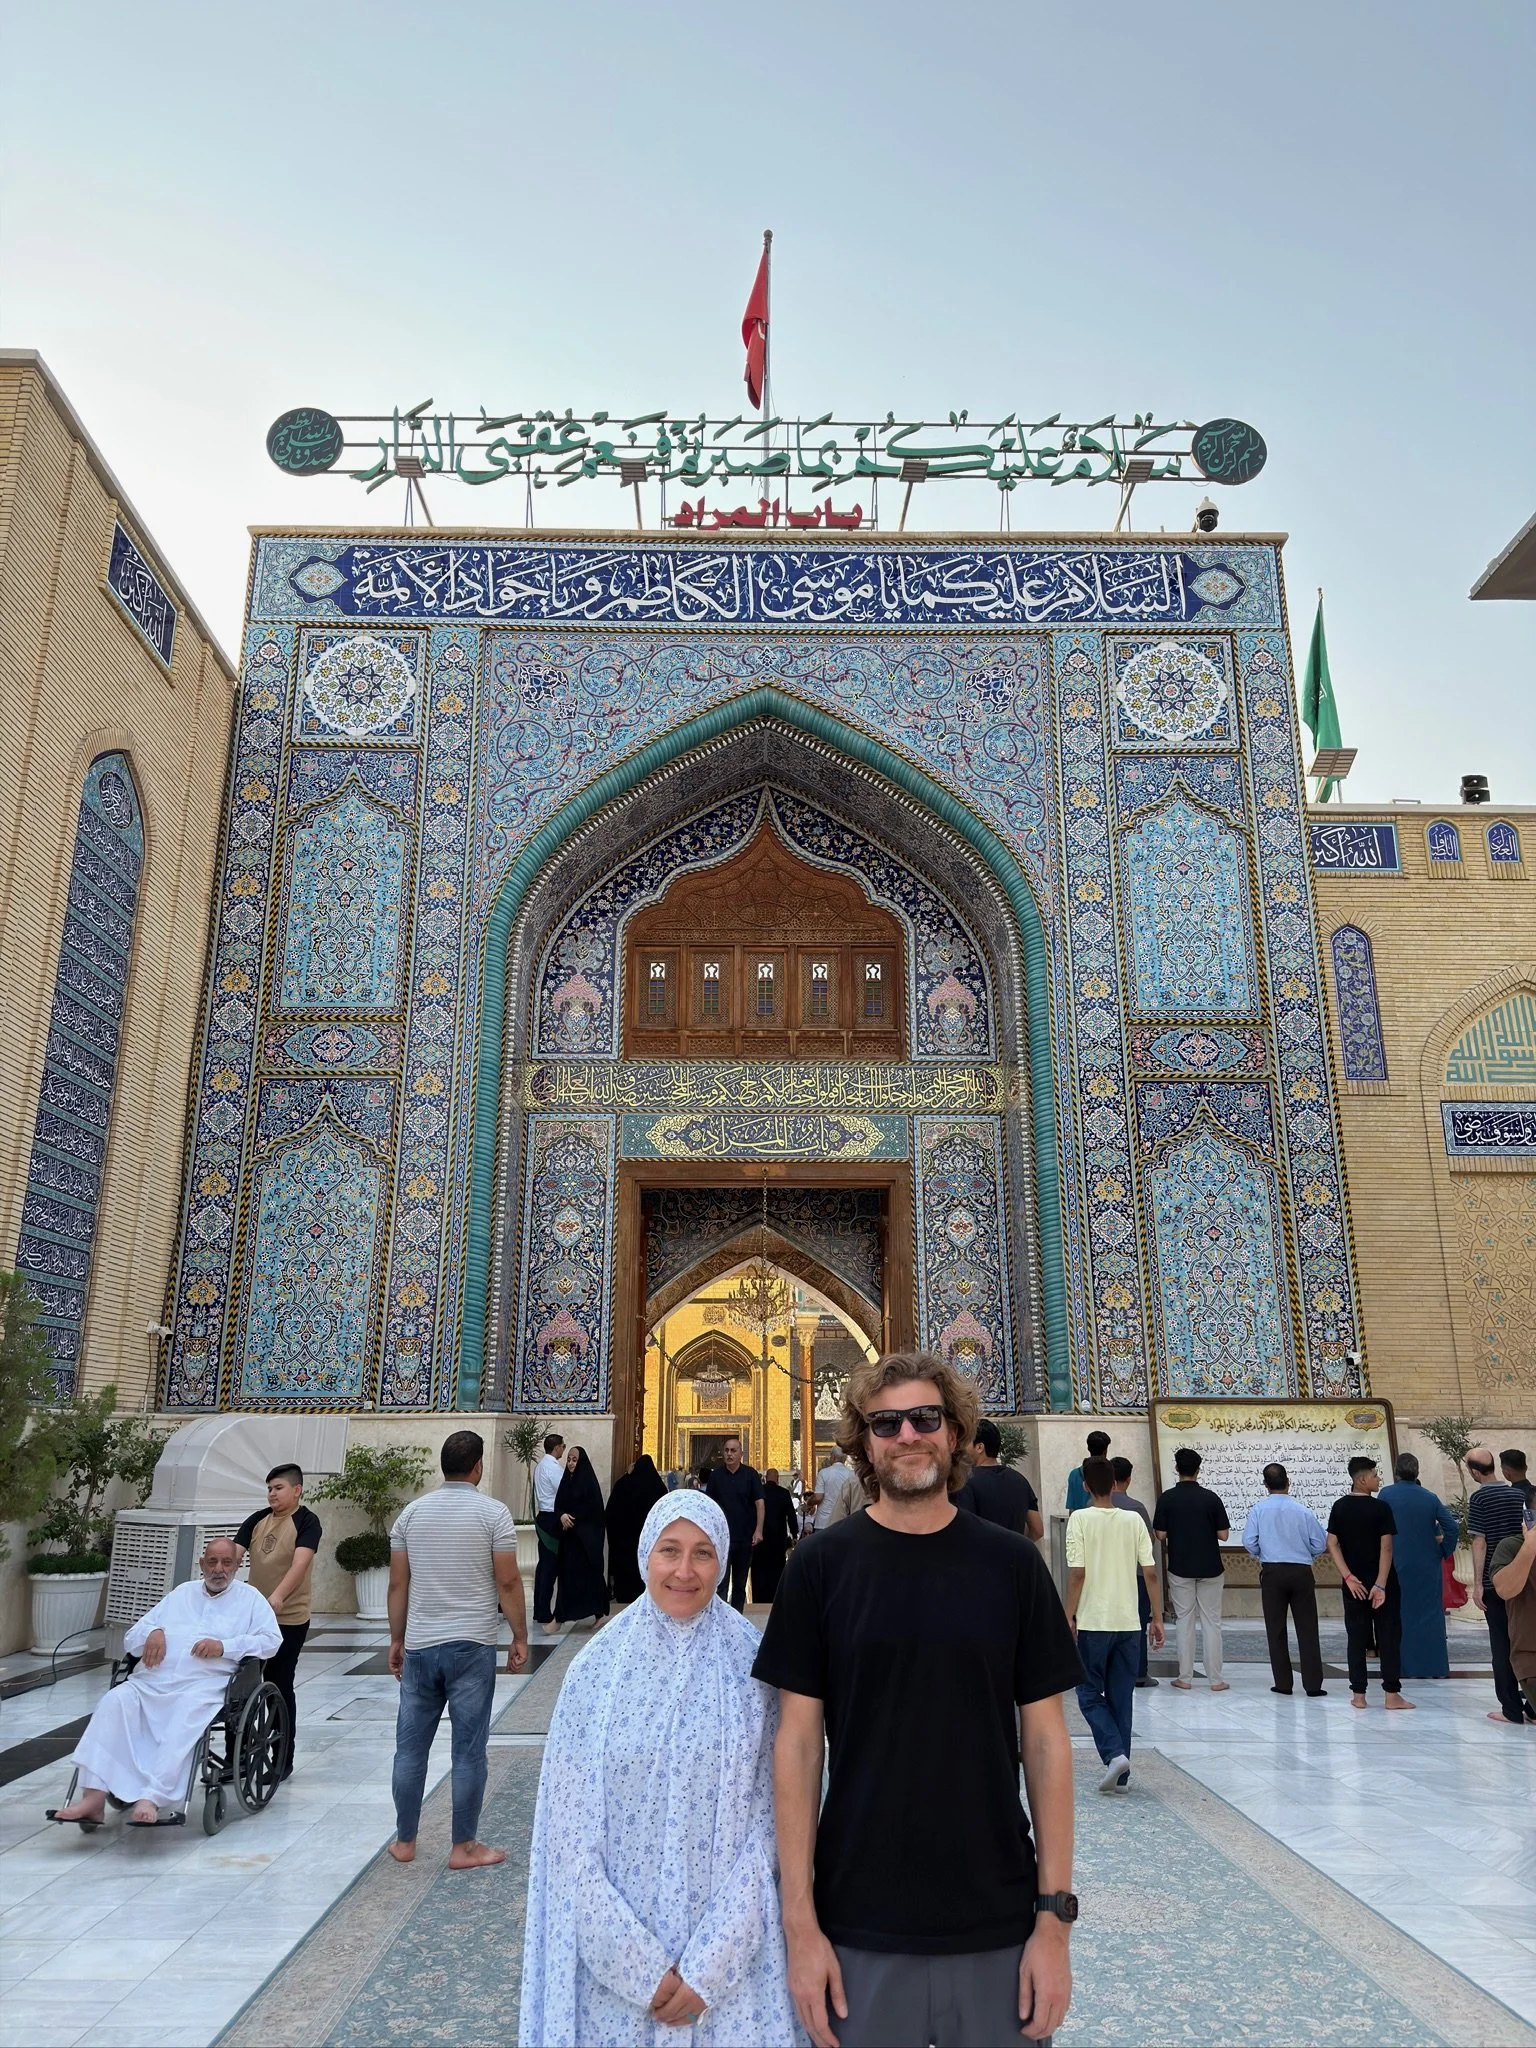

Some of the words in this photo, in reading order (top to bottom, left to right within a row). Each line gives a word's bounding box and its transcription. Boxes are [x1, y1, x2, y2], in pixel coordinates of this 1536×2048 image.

[673, 496, 780, 531] المراد
[786, 497, 863, 532] باب
[443, 553, 551, 616] جواد
[584, 553, 754, 621] الكاظم
[761, 556, 874, 621] موسى
[878, 555, 902, 620] يا
[898, 553, 1056, 620] عليكما
[1025, 553, 1186, 622] السلام
[1346, 826, 1382, 867] الله
[702, 1116, 787, 1155] المراد
[752, 1116, 829, 1156] باب
[1274, 1416, 1296, 1433] الكاظم
[1295, 1418, 1311, 1433] جعفر
[1318, 1418, 1336, 1433] موسى
